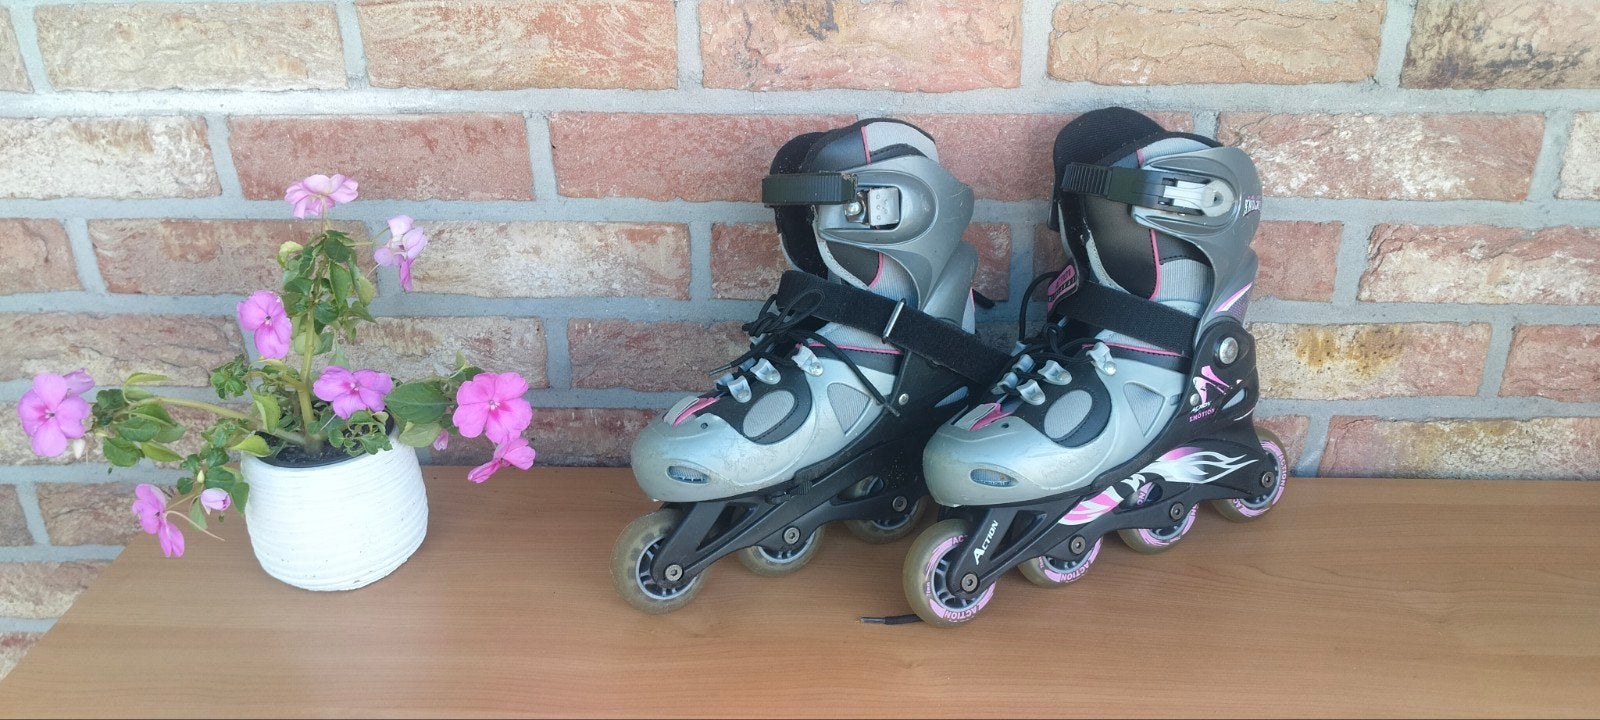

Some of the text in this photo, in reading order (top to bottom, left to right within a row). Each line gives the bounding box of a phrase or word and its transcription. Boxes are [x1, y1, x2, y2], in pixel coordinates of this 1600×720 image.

[1279, 454, 1287, 487] ACTION
[973, 520, 999, 566] ACTION
[1060, 562, 1089, 581] ACTION
[944, 607, 977, 620] ACTION
